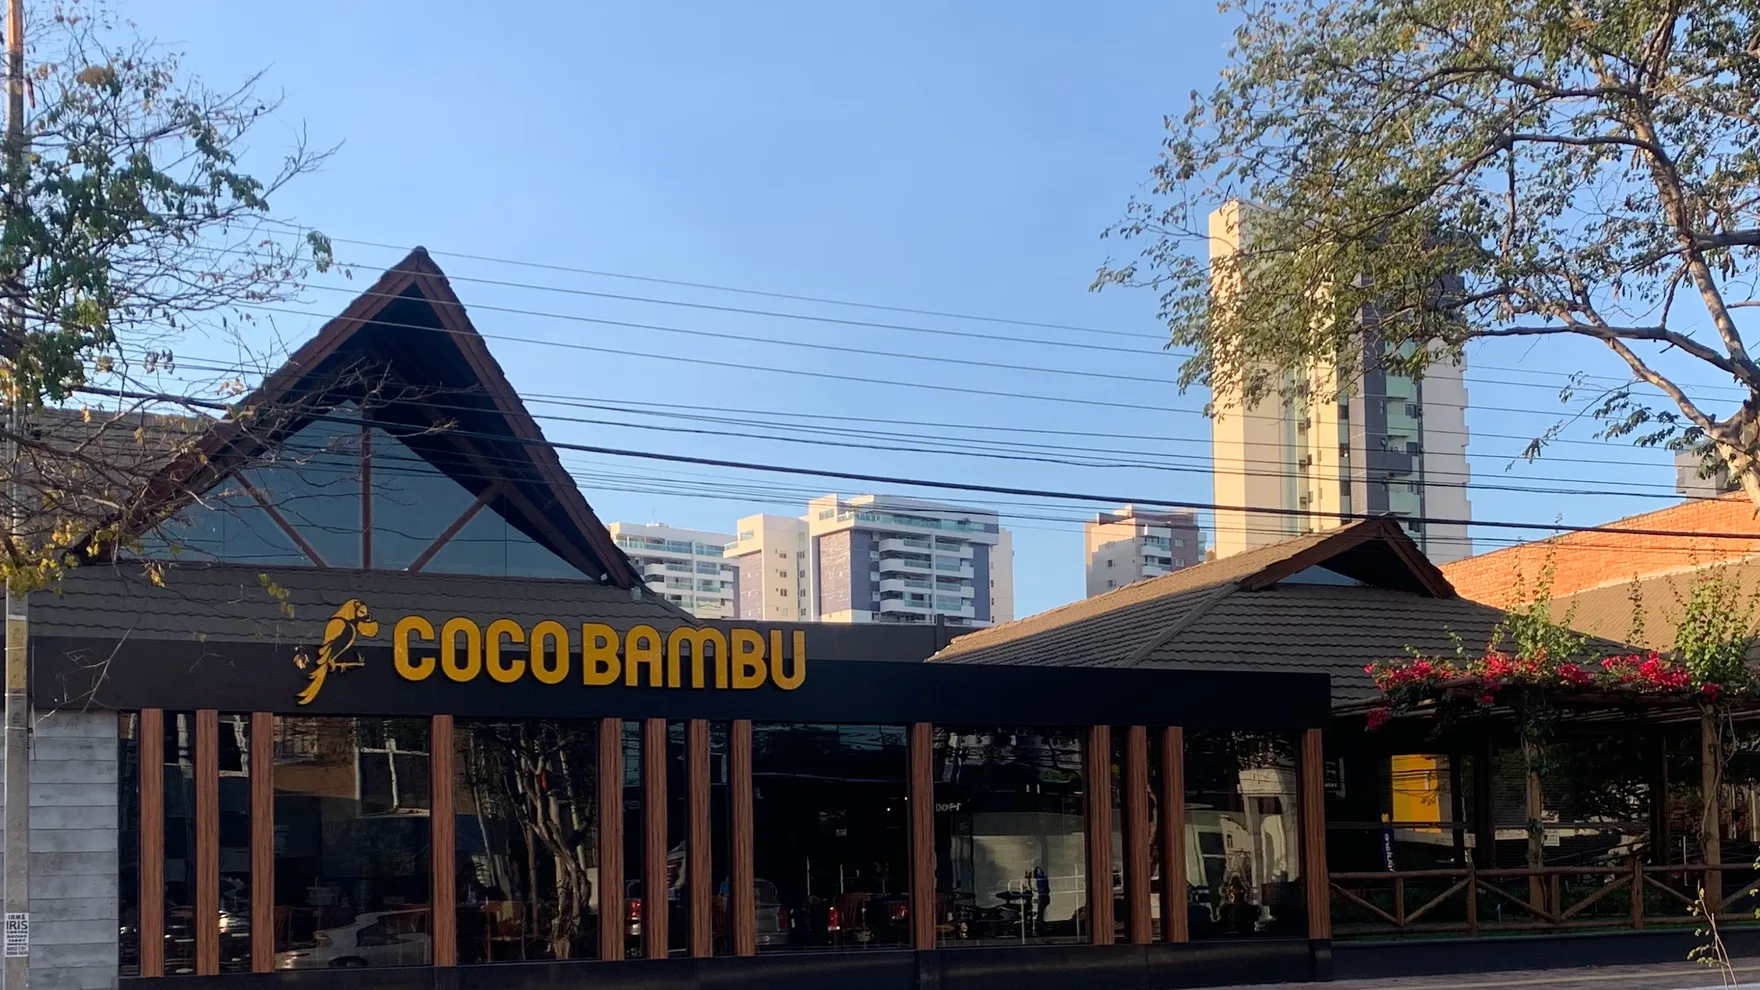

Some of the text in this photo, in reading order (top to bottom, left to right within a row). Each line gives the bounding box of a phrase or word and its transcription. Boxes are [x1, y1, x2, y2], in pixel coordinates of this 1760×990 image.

[394, 615, 806, 690] COCO BAMBU
[6, 921, 27, 930] IRIS
